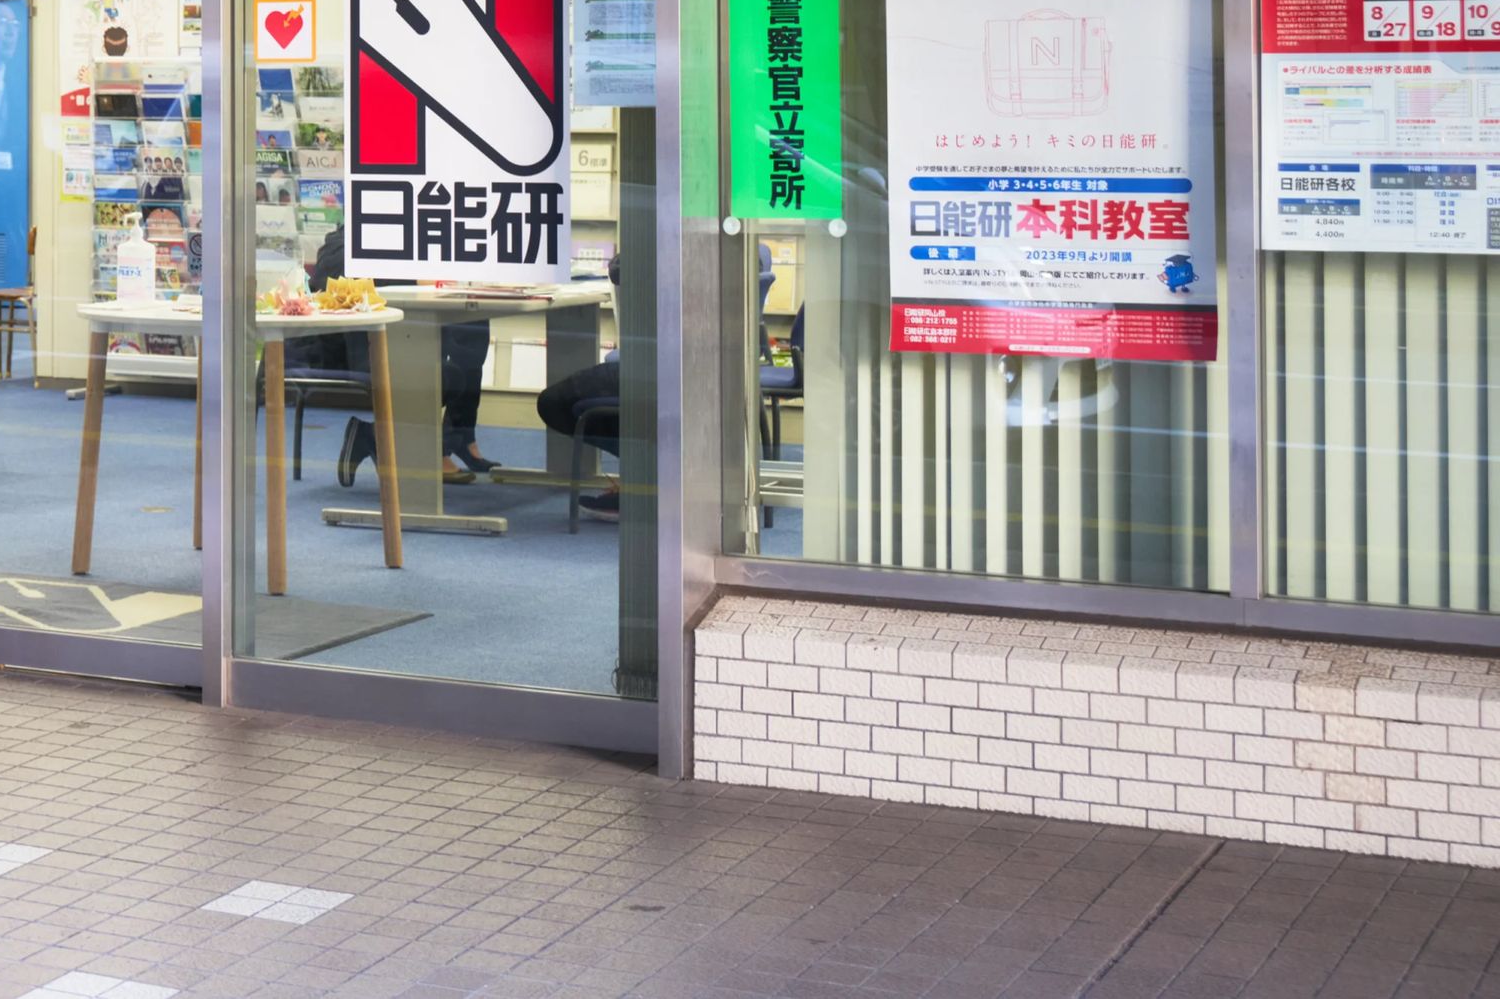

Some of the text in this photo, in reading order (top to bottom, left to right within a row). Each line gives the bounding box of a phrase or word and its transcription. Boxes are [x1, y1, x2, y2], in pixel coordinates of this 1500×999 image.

[1468, 5, 1489, 19] 10
[1383, 22, 1407, 37] 27
[1435, 22, 1456, 36] 18
[1289, 65, 1432, 75] ライバルとの差を分析する成績表
[306, 156, 337, 168] AICJ
[988, 179, 1009, 191] 小学
[1086, 179, 1108, 191] 対象
[1280, 177, 1356, 191] 日能研各校
[350, 180, 564, 265] 日能研
[909, 198, 1191, 241] 日能研本科教室
[1025, 250, 1132, 262] 2023年9月より開講
